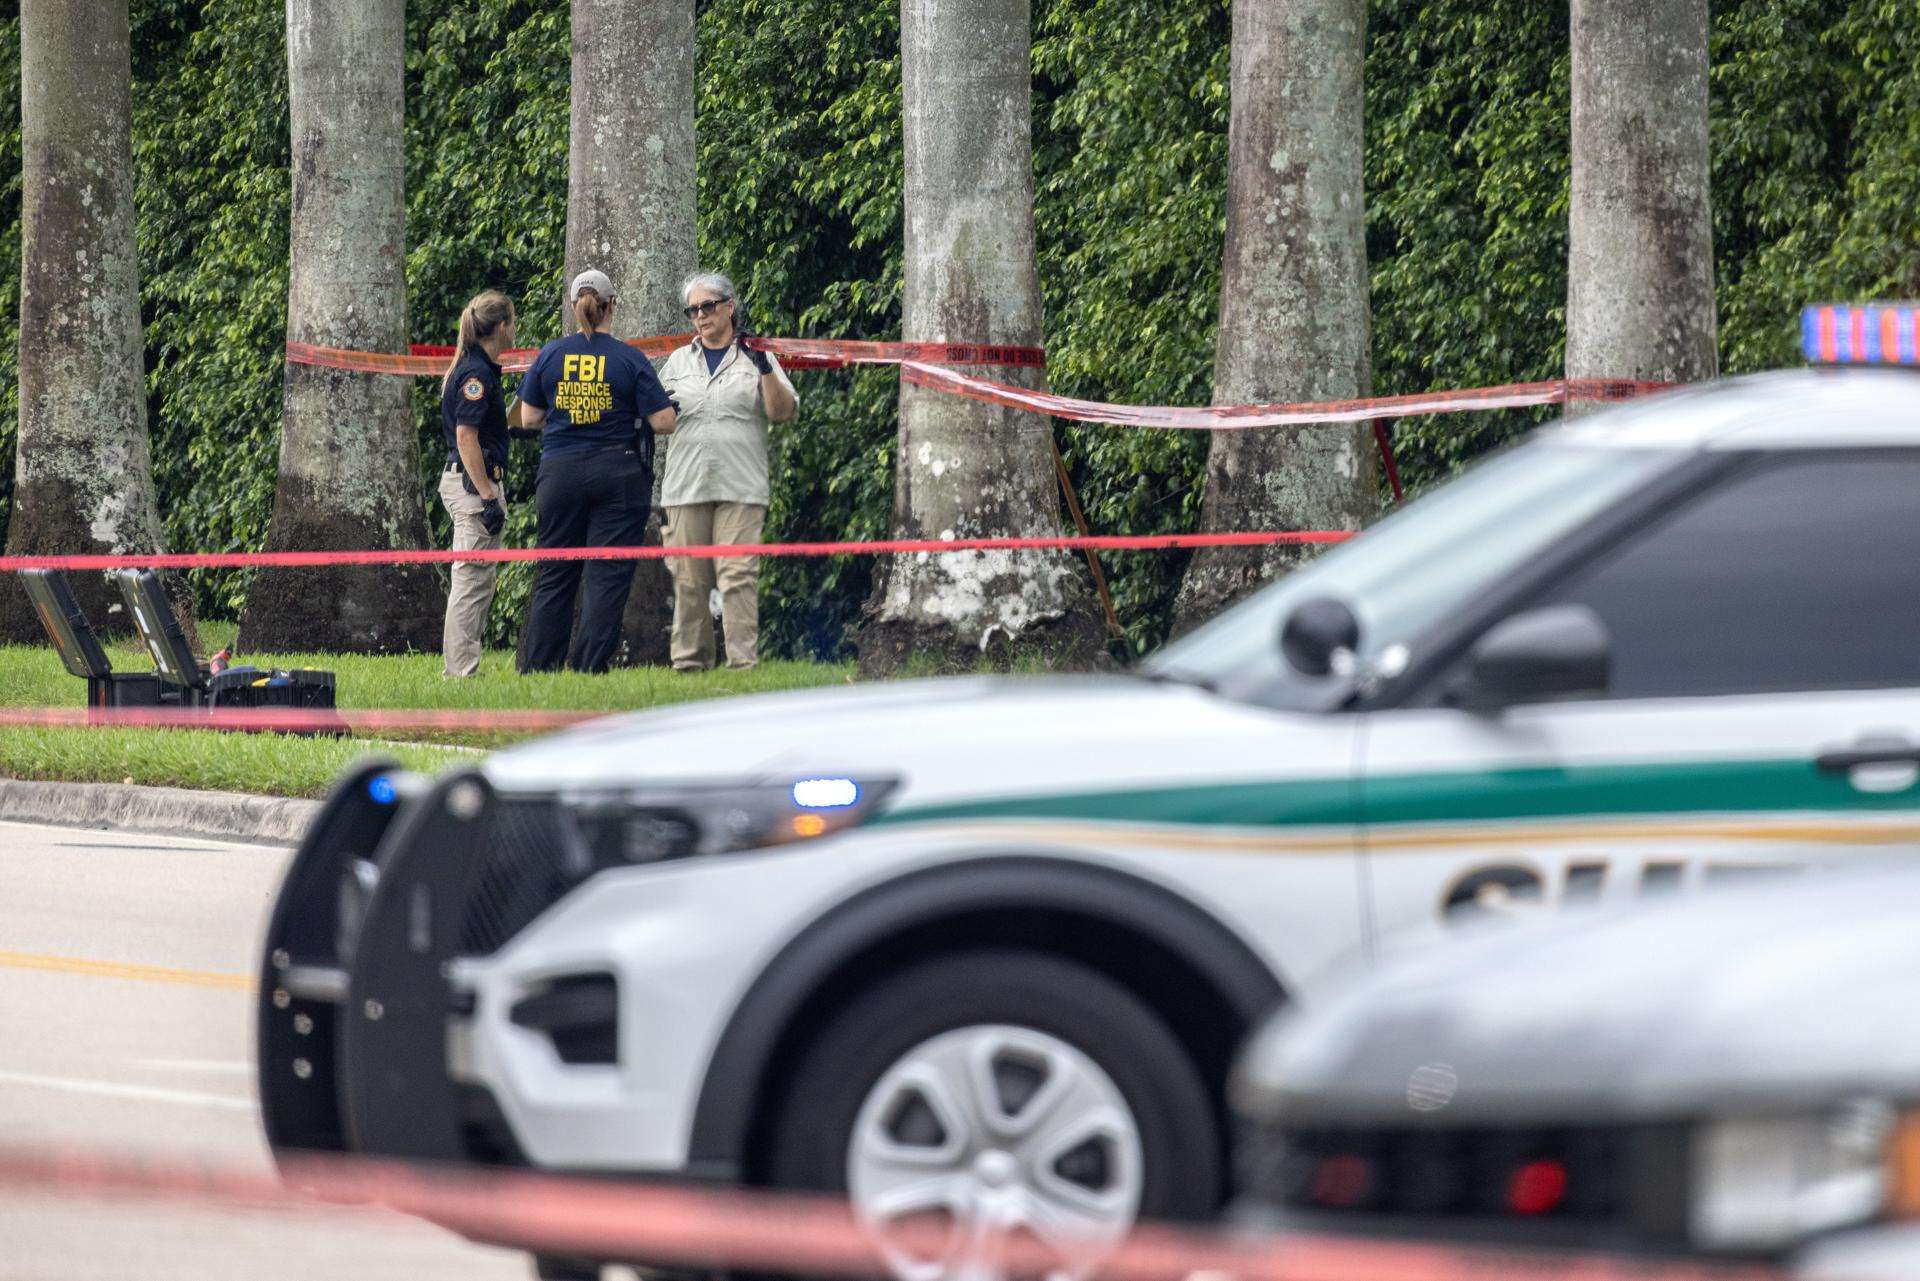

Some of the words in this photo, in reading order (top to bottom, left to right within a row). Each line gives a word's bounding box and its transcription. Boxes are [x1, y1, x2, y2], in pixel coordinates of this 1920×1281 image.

[564, 354, 605, 382] FBI
[558, 382, 610, 396] EVIDENCE
[556, 396, 612, 410] RESPONSE
[569, 410, 600, 424] TEAM
